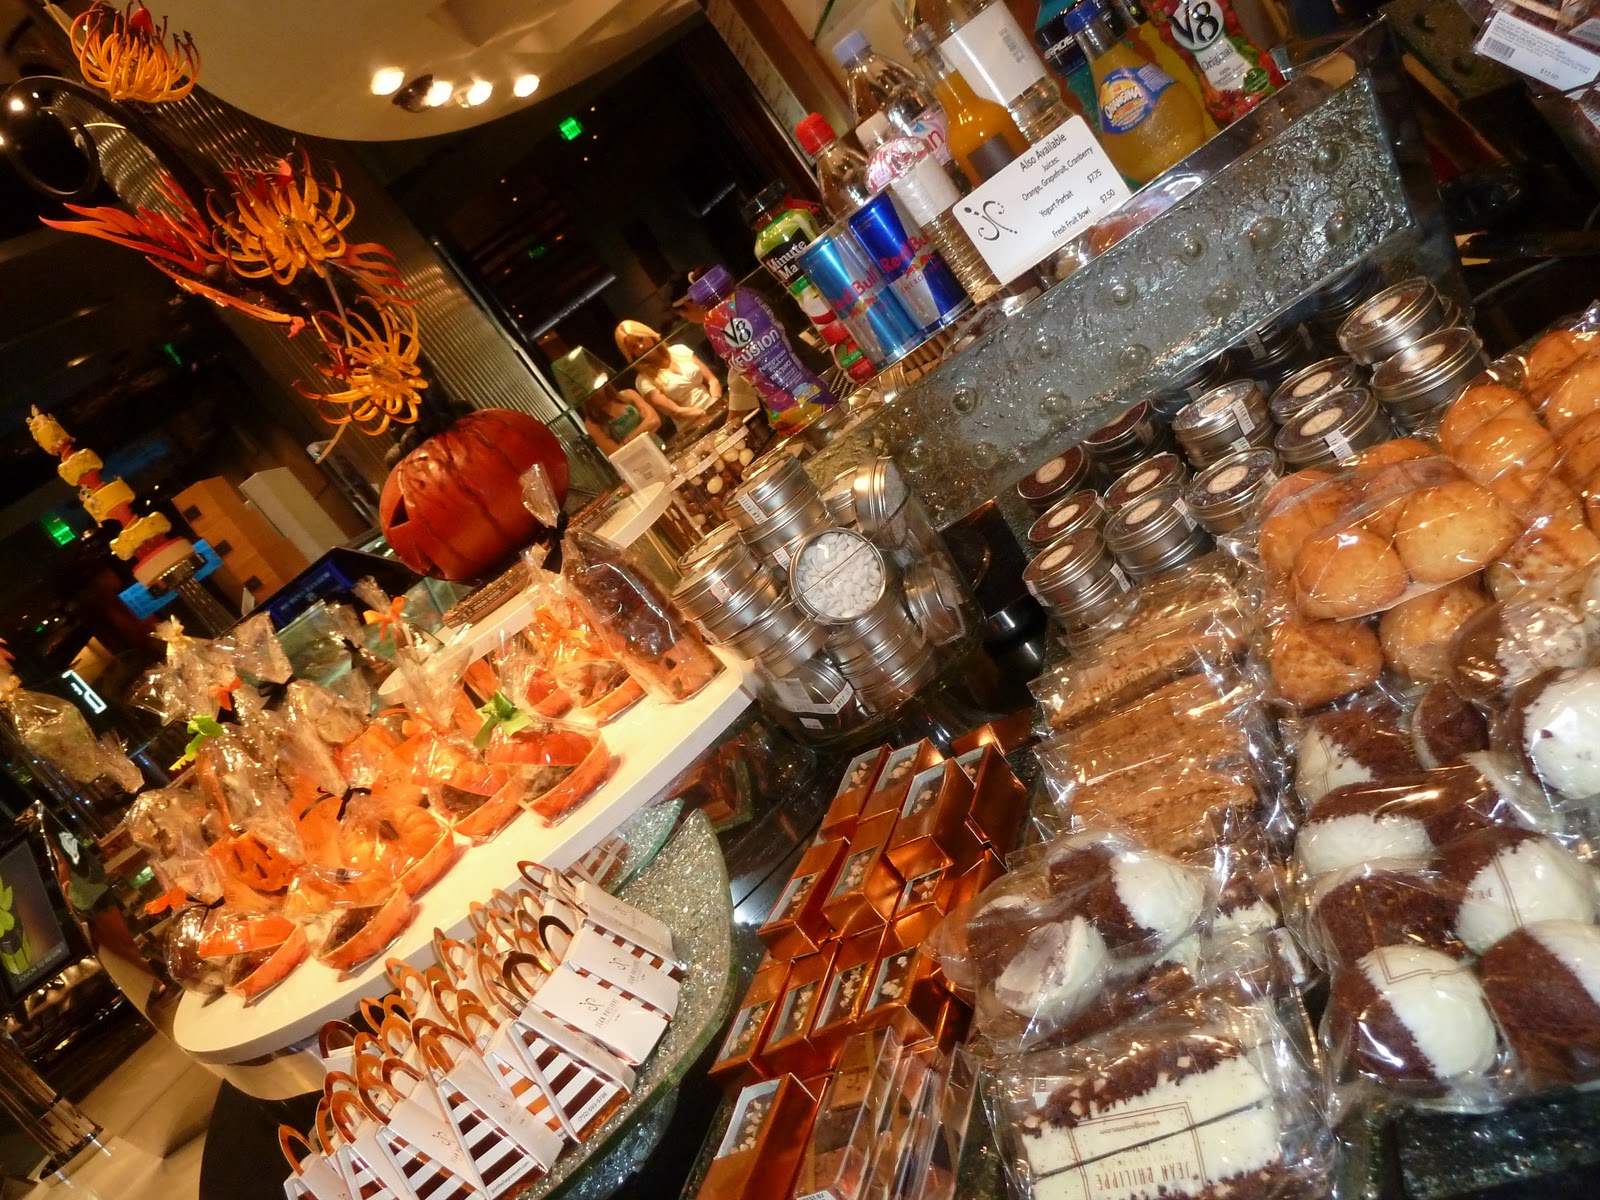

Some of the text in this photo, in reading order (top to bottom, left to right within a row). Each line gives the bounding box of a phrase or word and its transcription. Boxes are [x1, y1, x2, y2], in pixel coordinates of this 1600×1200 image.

[1167, 0, 1218, 45] V8
[1201, 46, 1234, 71] Original
[1104, 85, 1143, 120] ORANGINA
[1020, 132, 1067, 172] Also Available
[1042, 157, 1060, 172] Juices:
[1022, 146, 1094, 202] Orange, Grapefruit, Cranberry
[1039, 170, 1102, 218] Yogurt Parfait $7.75
[1052, 189, 1116, 238] Fresh Fruit Bowl $7.50
[767, 240, 806, 272] Minute
[879, 246, 911, 274] Red
[906, 233, 930, 258] Bu
[778, 262, 799, 280] Ma
[852, 267, 880, 298] Bull
[721, 317, 754, 346] V8
[1096, 1162, 1190, 1191] JEAN PHILIPPE
